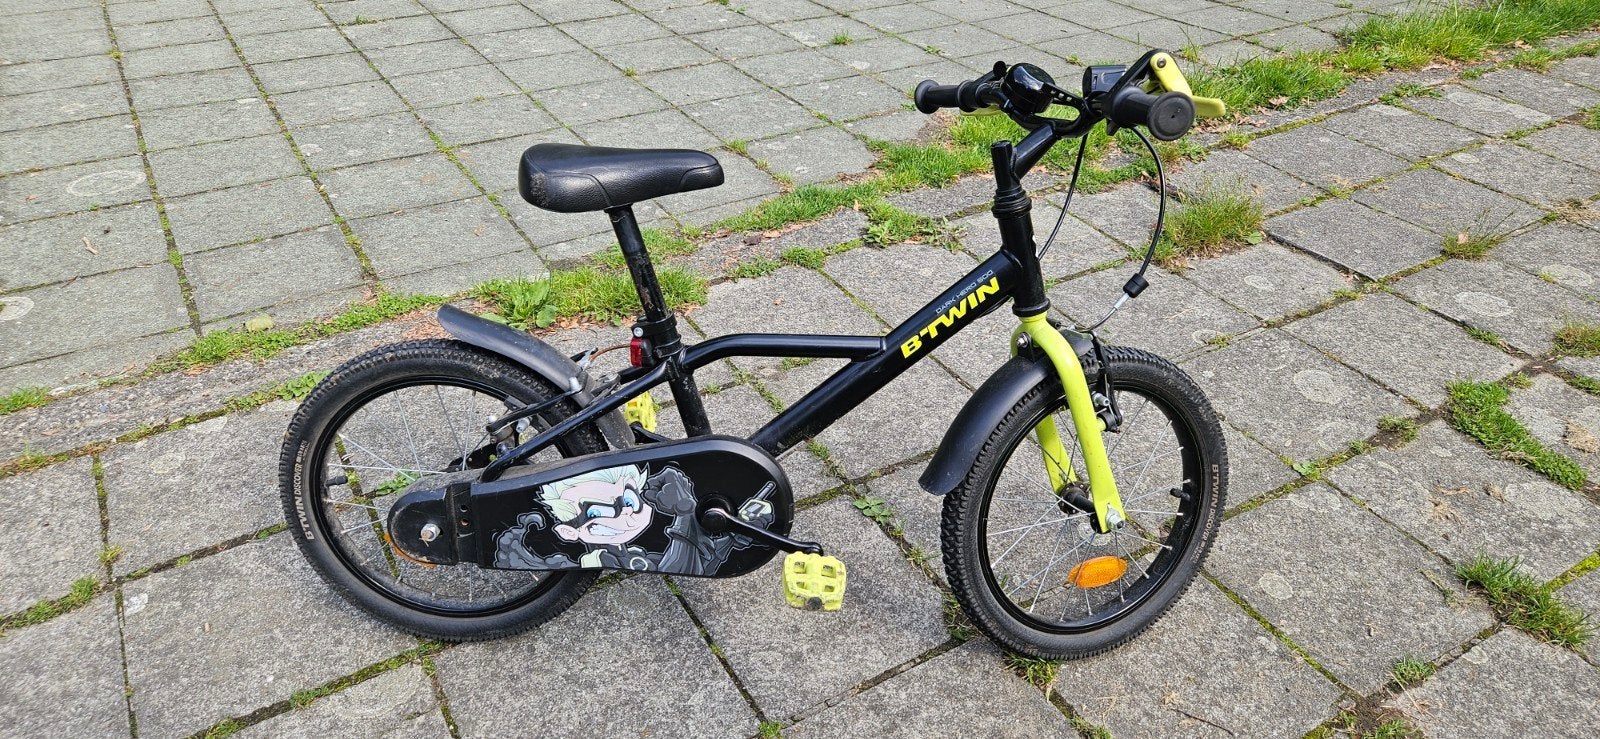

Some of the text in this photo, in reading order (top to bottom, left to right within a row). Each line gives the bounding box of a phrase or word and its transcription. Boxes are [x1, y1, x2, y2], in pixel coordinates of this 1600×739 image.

[935, 297, 956, 314] DARK
[956, 282, 977, 298] HERO
[293, 462, 303, 496] DISCOVER
[1202, 507, 1217, 541] DISCOVER
